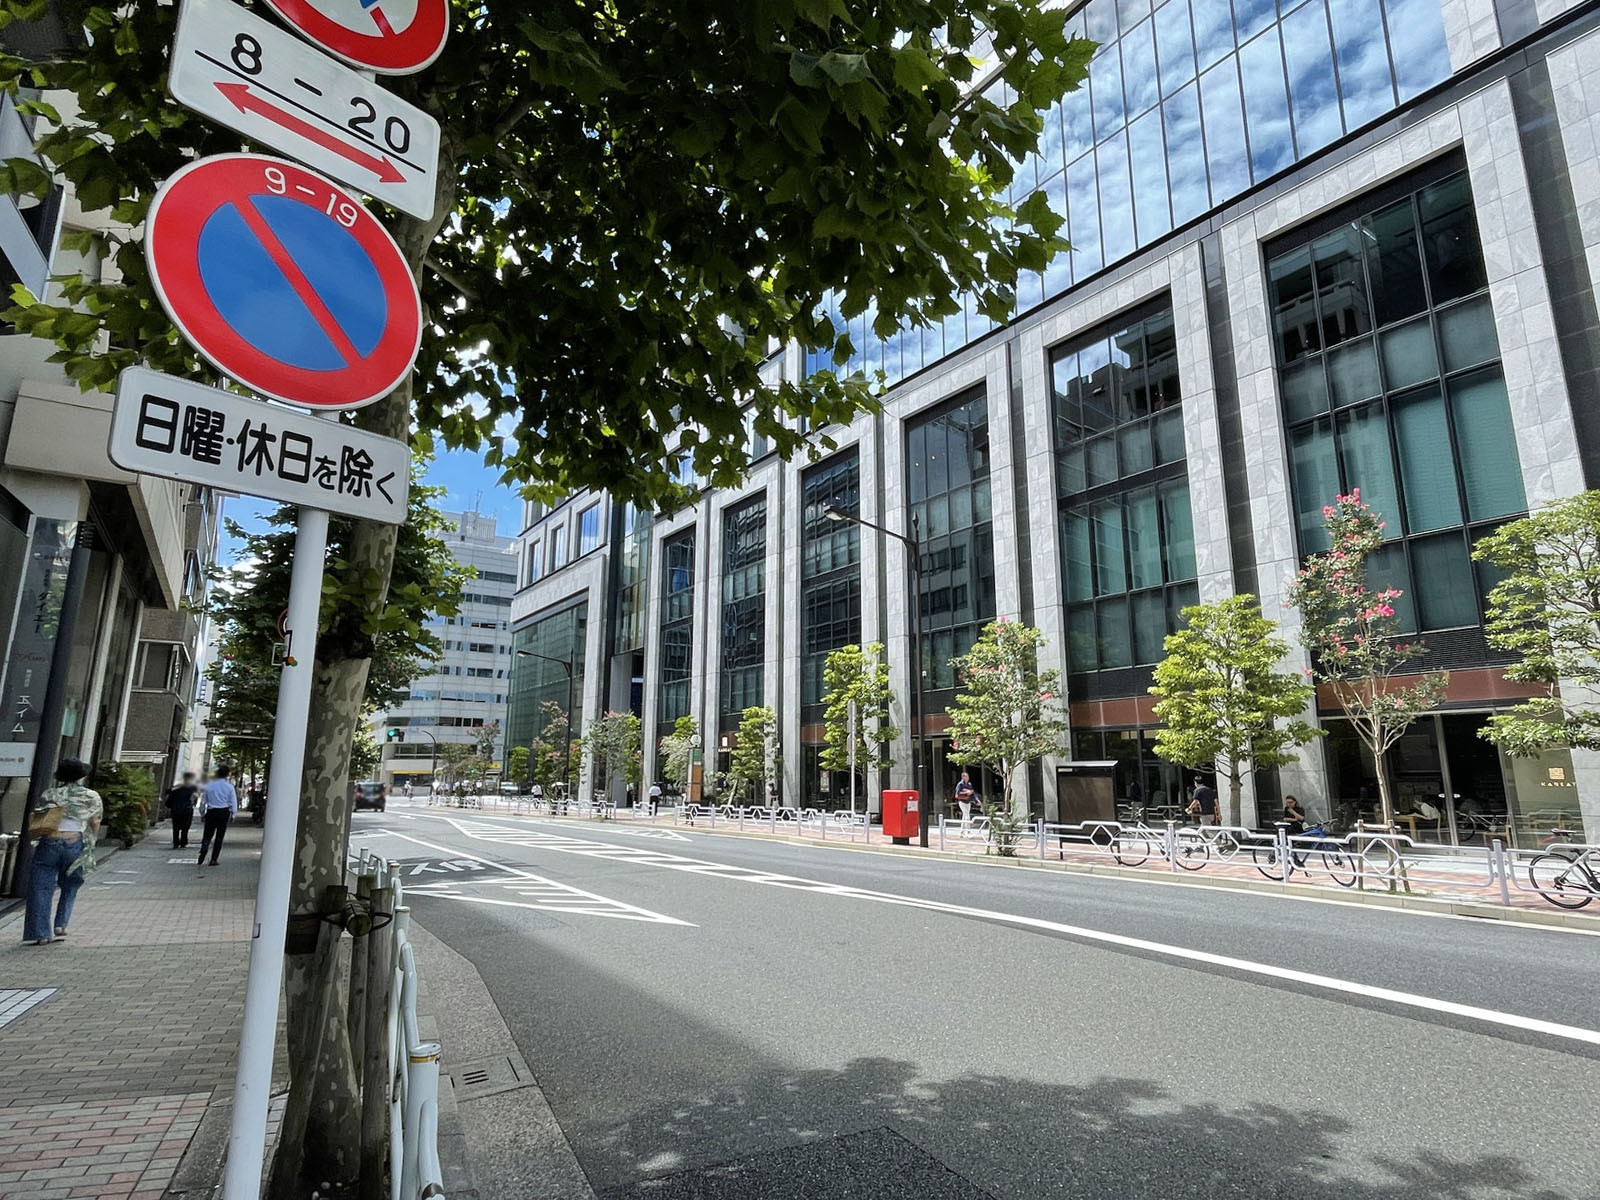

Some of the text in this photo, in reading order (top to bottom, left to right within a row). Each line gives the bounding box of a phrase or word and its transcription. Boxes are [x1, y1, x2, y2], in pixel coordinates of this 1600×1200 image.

[136, 394, 395, 504] 日曜・休日を除く
